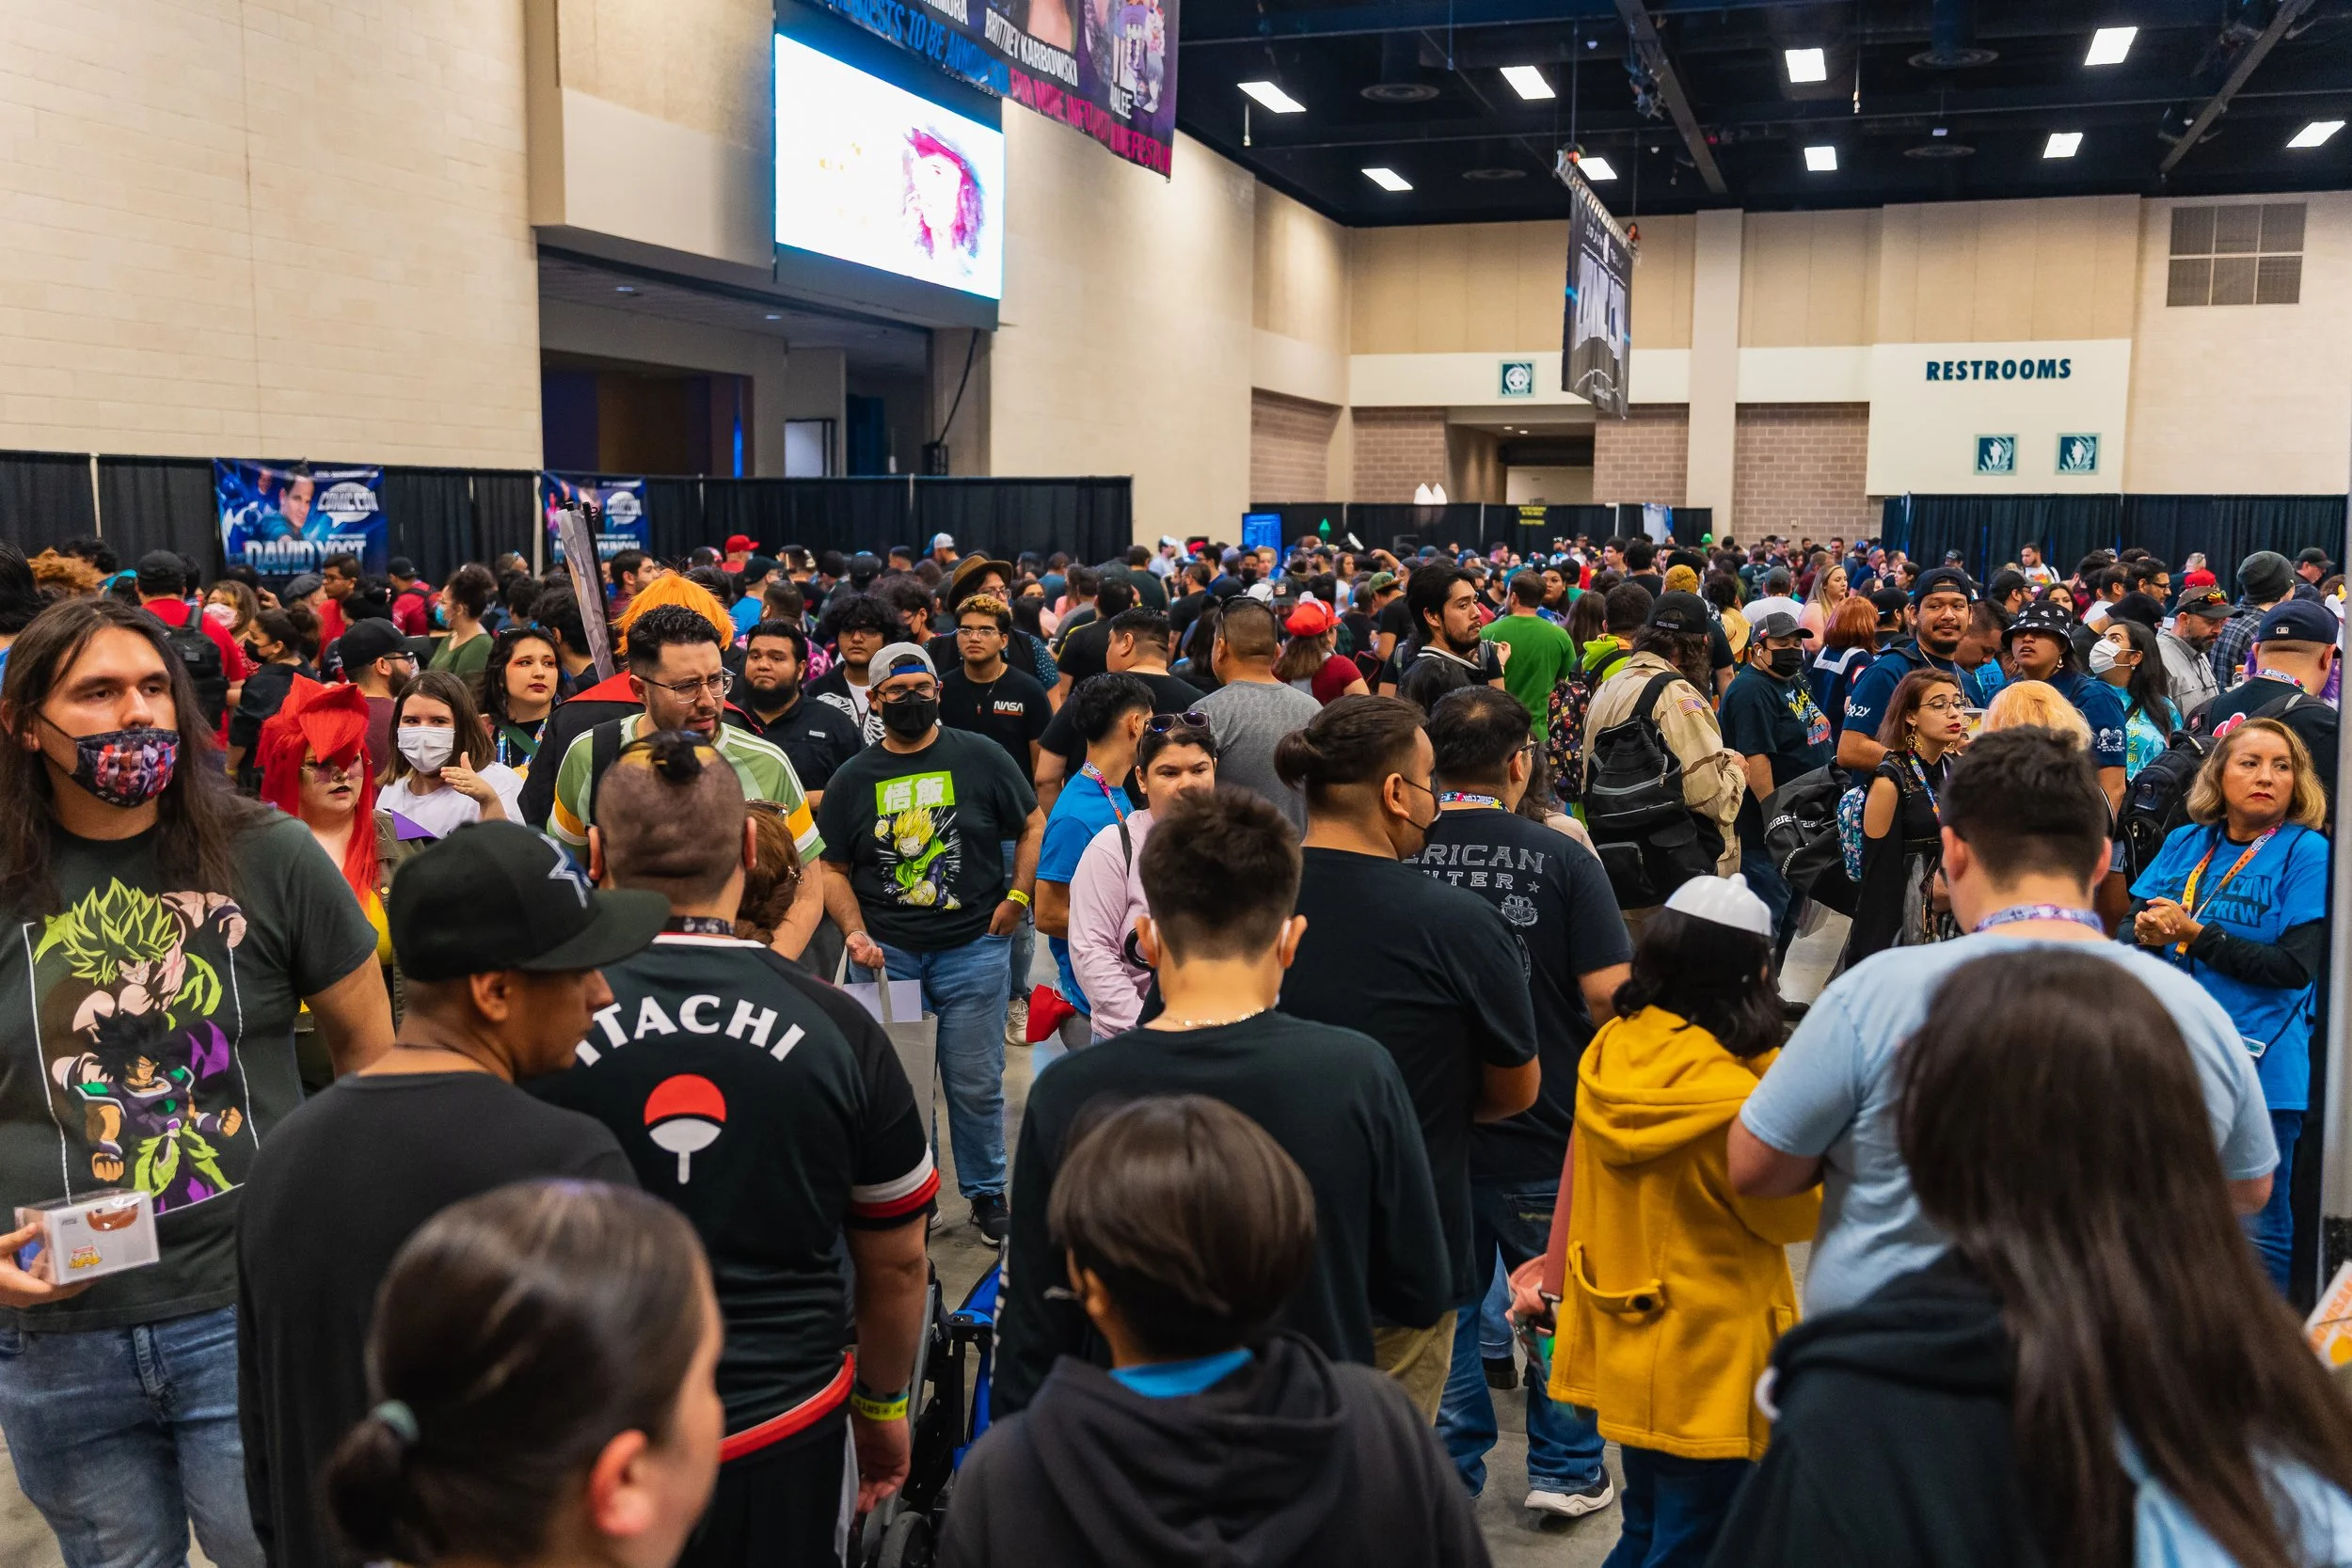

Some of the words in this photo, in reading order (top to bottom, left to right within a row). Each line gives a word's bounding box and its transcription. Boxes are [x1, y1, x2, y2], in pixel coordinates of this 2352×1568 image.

[908, 8, 927, 50] TO
[926, 18, 946, 61] BE
[1021, 33, 1078, 87] KARBOWSKI
[1066, 94, 1093, 133] INFO
[1926, 358, 2072, 381] RESTROOMS
[245, 540, 315, 575] DAVID
[993, 700, 1024, 713] NASA
[883, 777, 945, 813] 悟飯
[2227, 875, 2270, 906] CON
[2203, 900, 2259, 926] CREW
[575, 994, 806, 1068] ITACHI
